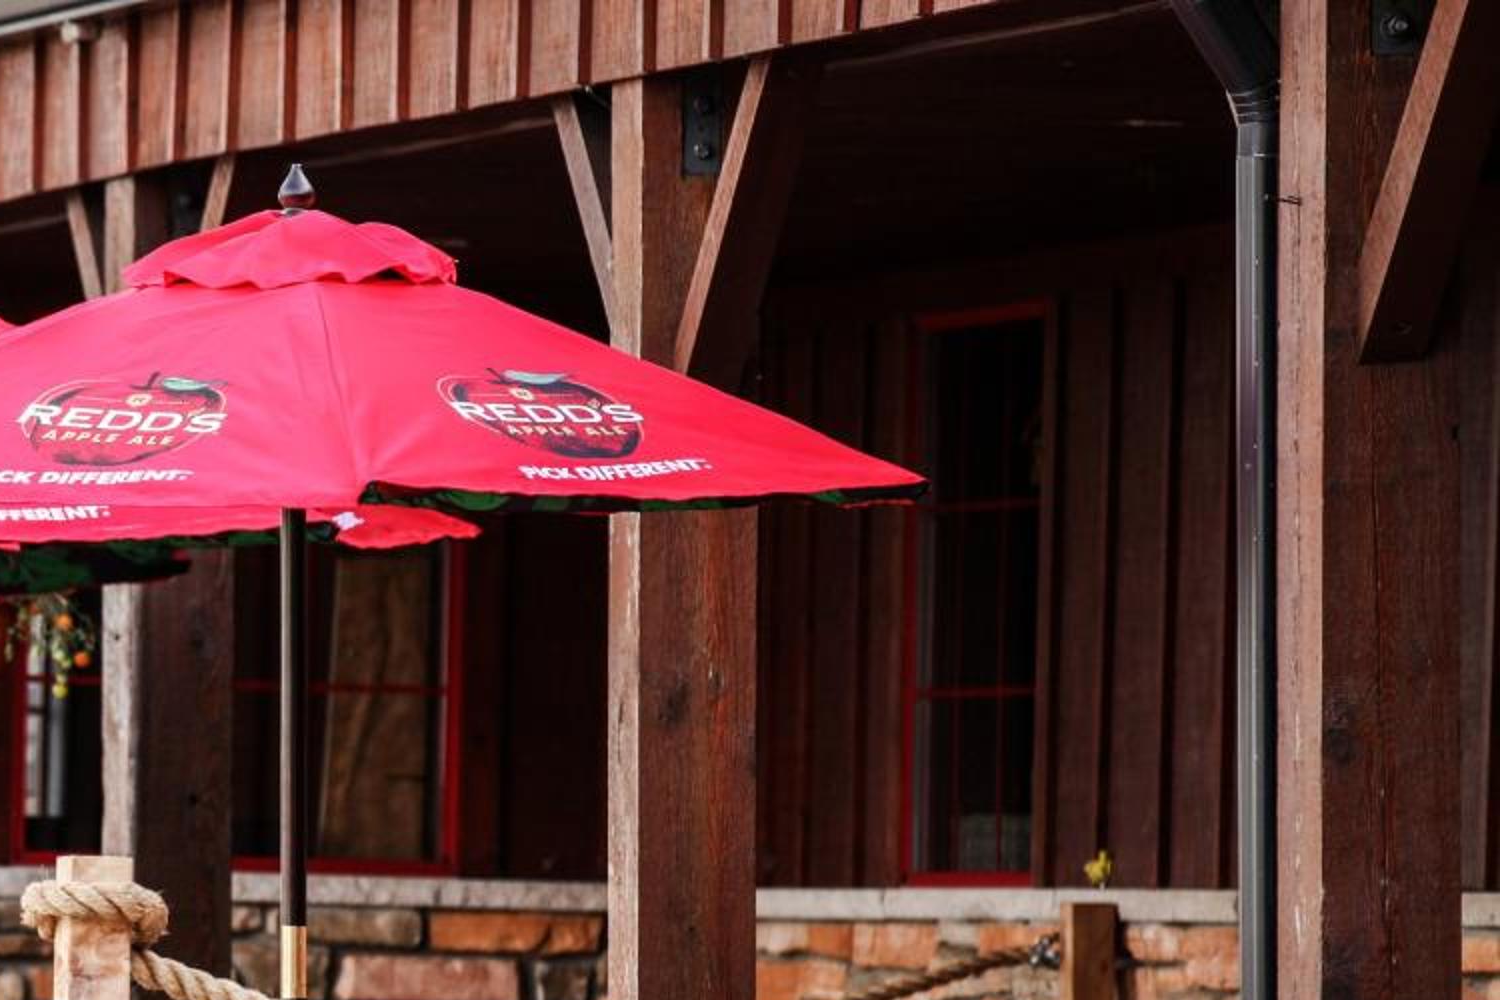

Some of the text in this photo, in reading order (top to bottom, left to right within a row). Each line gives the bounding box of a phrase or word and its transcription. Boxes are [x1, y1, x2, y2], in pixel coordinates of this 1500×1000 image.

[41, 430, 175, 446] APPLE ALE
[505, 424, 629, 436] APPLE ALE
[517, 464, 575, 480] PICK
